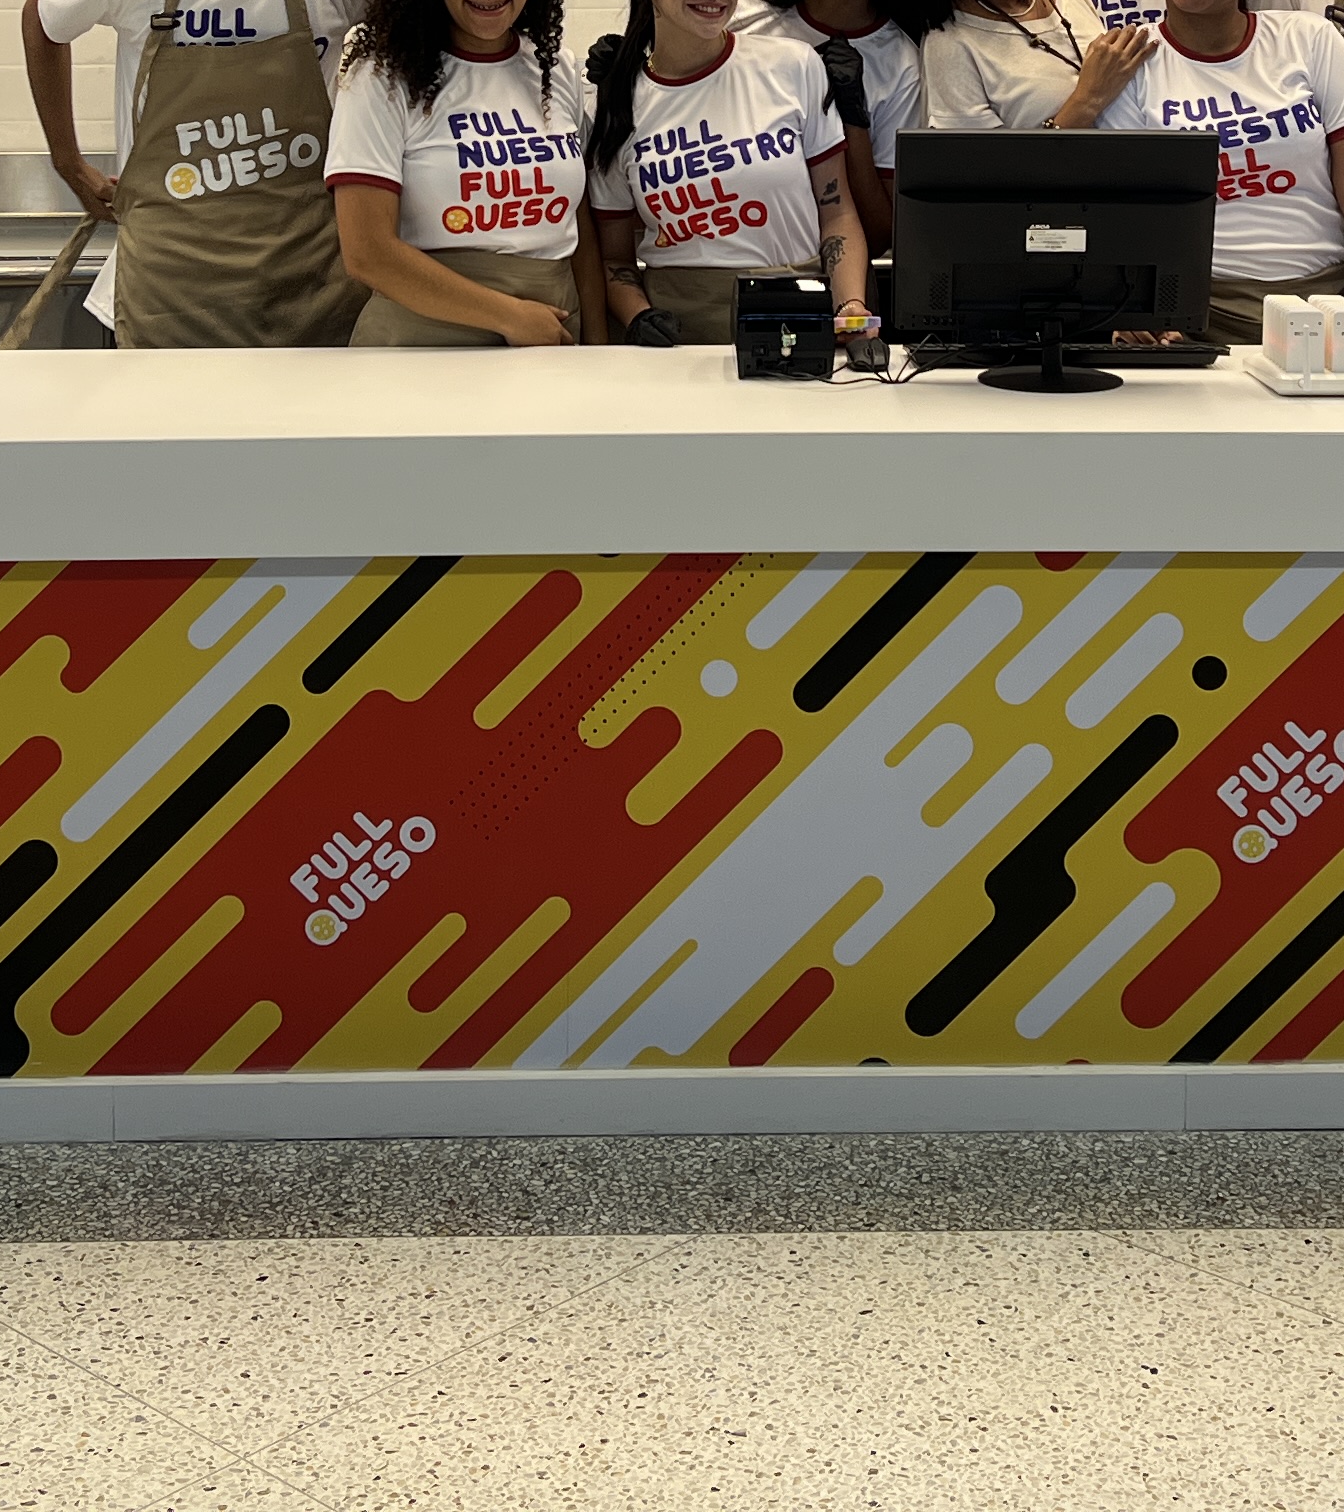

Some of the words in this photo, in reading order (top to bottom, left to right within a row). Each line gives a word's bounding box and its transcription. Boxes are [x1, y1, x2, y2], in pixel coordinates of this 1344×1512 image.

[175, 107, 290, 156] FULL
[447, 108, 537, 140] FULL
[1162, 91, 1257, 126] FULL
[634, 119, 723, 162] FULL
[639, 127, 797, 193] NUESTRO
[165, 133, 321, 200] QUESO
[460, 167, 555, 202] FULL
[442, 196, 570, 234] QUESO
[644, 177, 739, 220] FULL
[1216, 721, 1327, 818] FULL
[289, 811, 393, 903] FULL
[304, 816, 436, 946] QUESO
